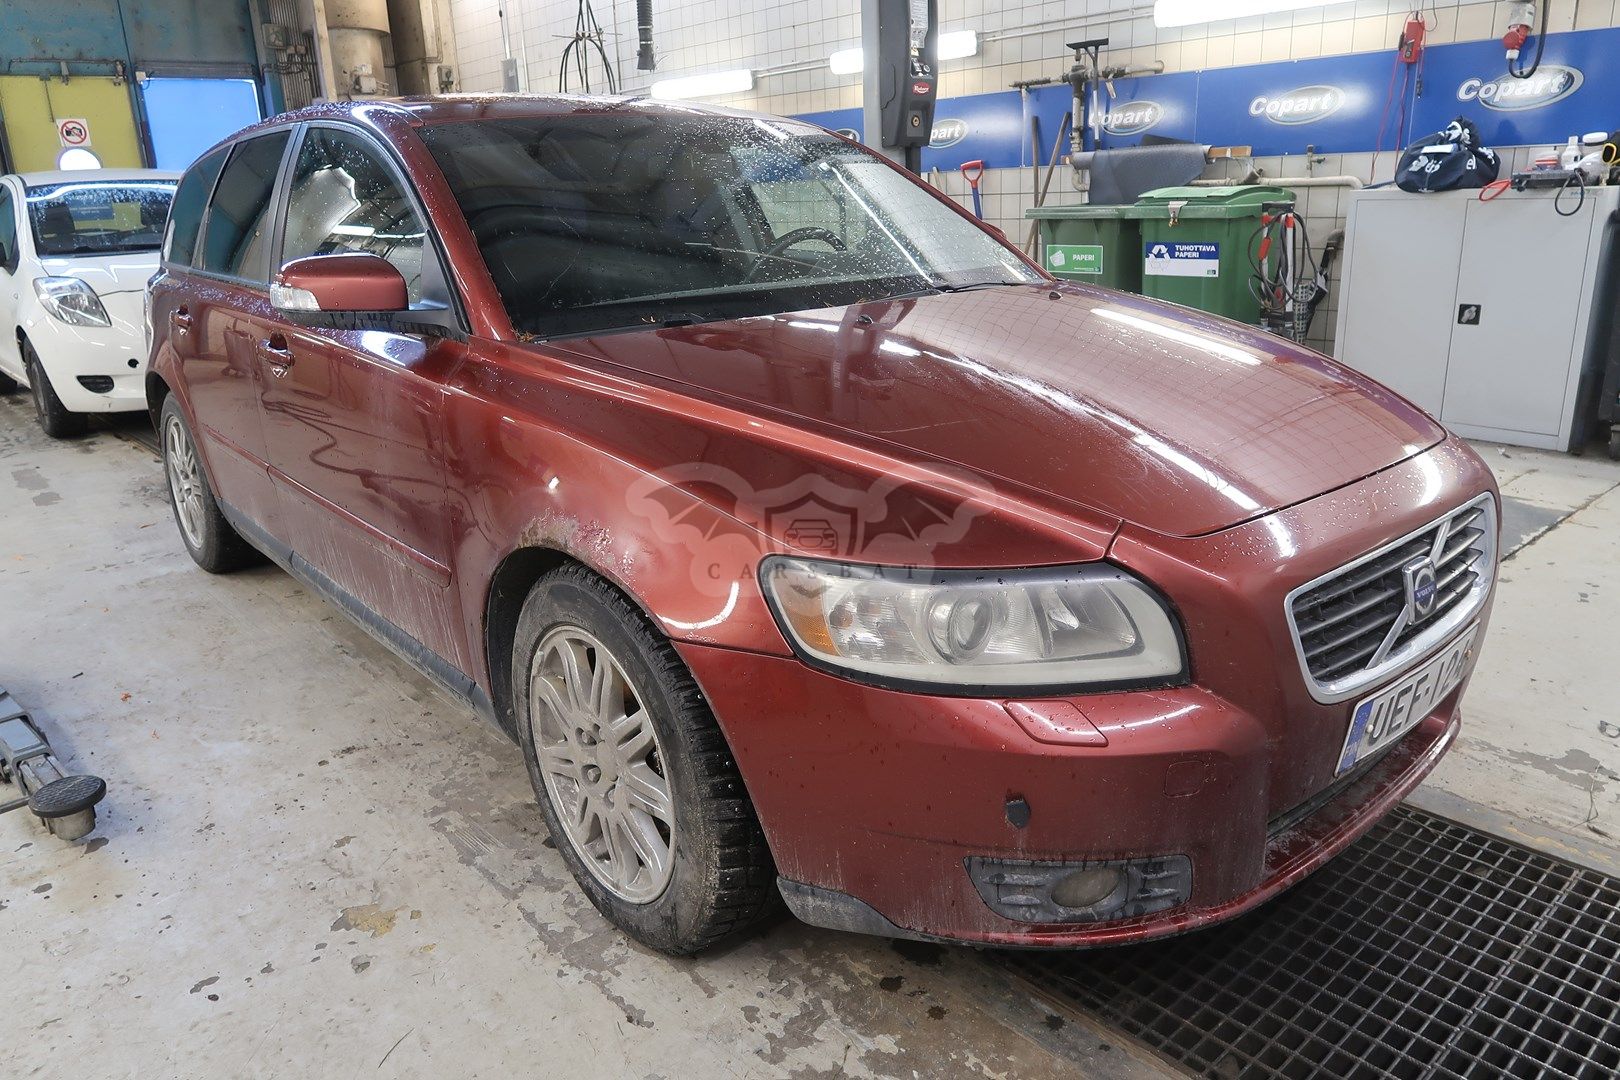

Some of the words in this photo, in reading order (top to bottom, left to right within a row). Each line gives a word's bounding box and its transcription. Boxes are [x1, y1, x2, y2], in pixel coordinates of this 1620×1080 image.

[1458, 70, 1569, 102] Copart
[1249, 92, 1333, 118] Copart
[930, 124, 961, 143] part
